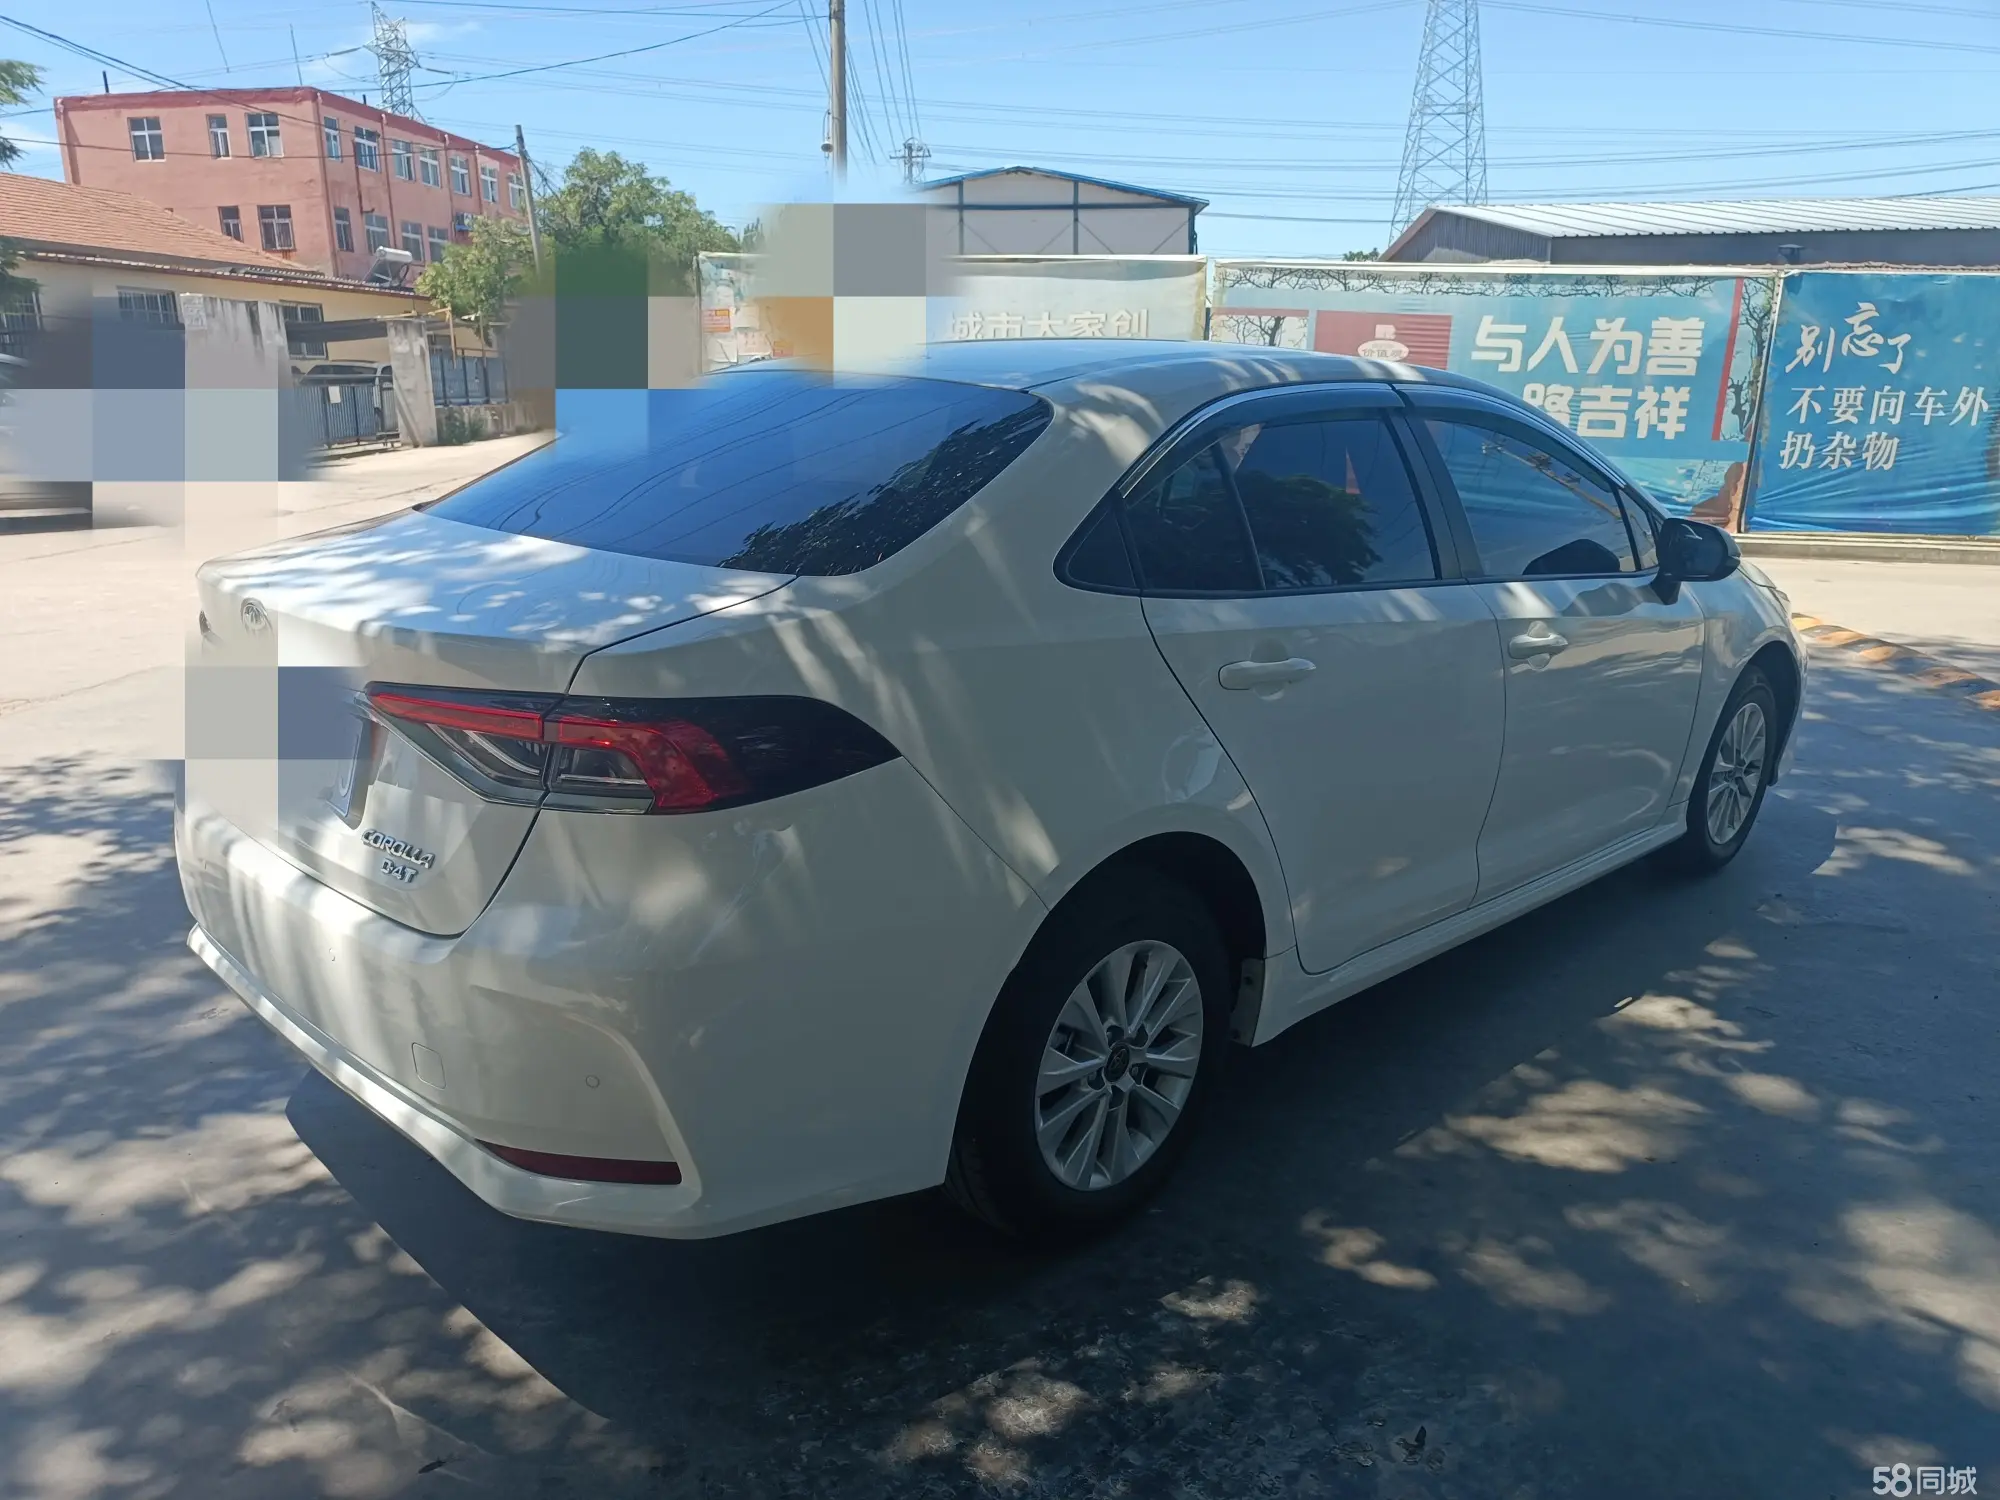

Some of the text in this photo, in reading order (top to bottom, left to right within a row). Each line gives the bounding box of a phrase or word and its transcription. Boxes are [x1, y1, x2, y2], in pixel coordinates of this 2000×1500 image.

[1471, 315, 1705, 376] 与人为善
[1785, 302, 1911, 374] 别忘了
[1786, 385, 1989, 426] 不要向车外
[1779, 431, 1900, 470] 扔杂物
[361, 829, 435, 869] COROLLA
